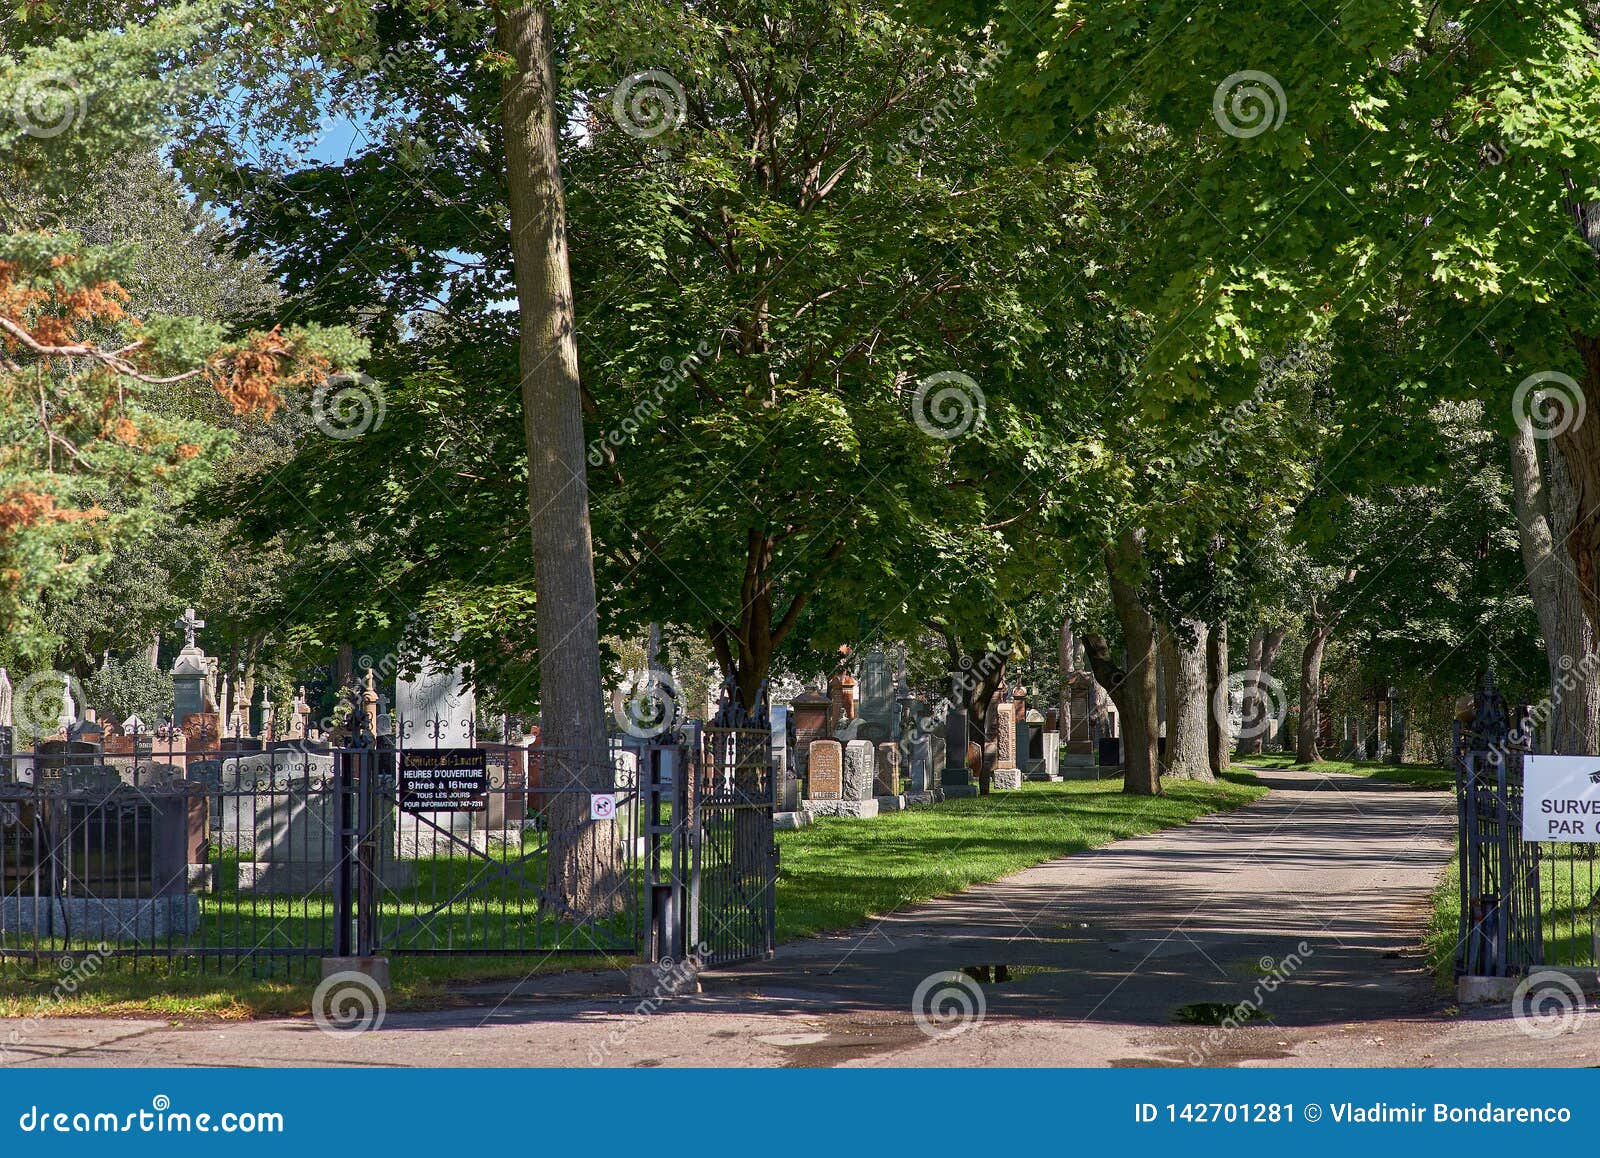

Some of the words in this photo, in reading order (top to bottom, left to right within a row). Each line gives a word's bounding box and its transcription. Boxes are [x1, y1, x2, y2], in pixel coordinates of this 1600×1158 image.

[403, 769, 432, 779] HEURES
[434, 769, 483, 778] D'OUVERTURE
[1548, 820, 1584, 834] PAR
